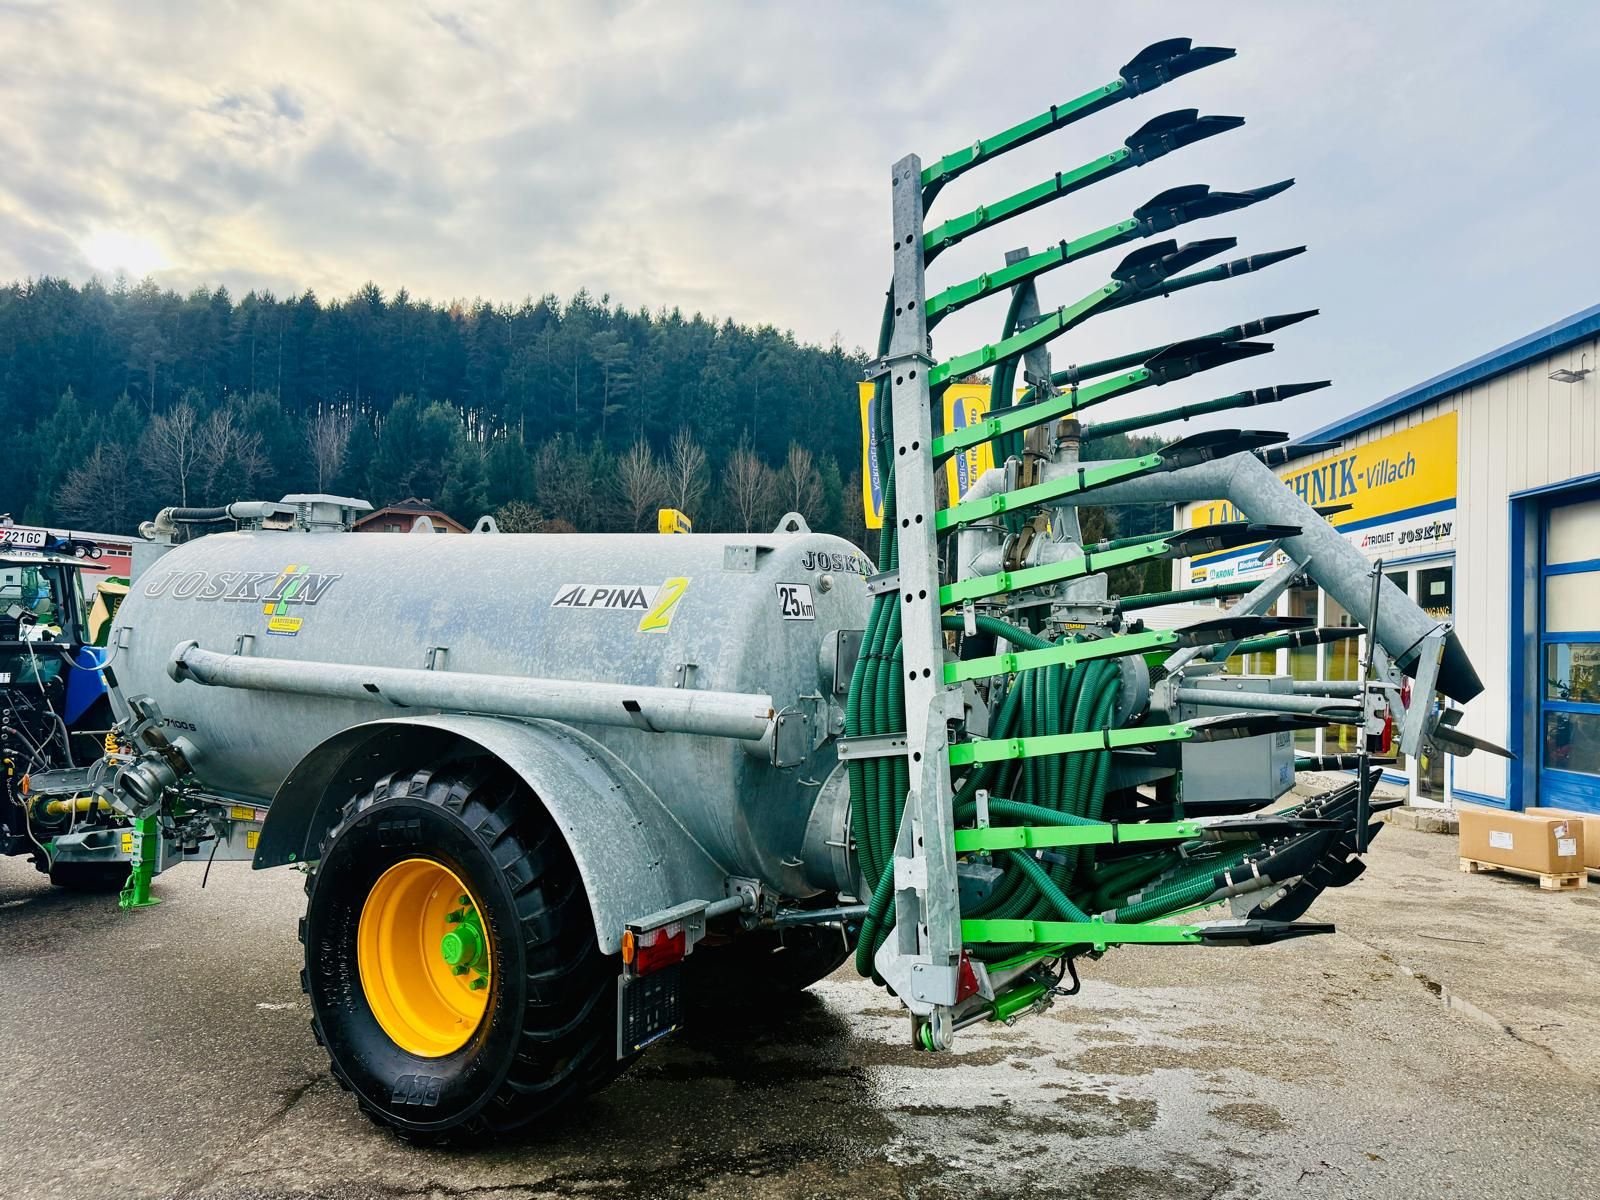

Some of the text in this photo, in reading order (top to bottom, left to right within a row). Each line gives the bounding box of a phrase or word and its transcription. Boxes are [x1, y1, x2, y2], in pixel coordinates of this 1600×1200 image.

[4, 531, 41, 544] 221GC
[1368, 532, 1394, 545] TRIOLIET
[1398, 522, 1452, 544] JOSKIN
[802, 551, 873, 576] JOSKIN
[144, 570, 344, 605] JOSKIN
[553, 576, 688, 631] ALPINA 2
